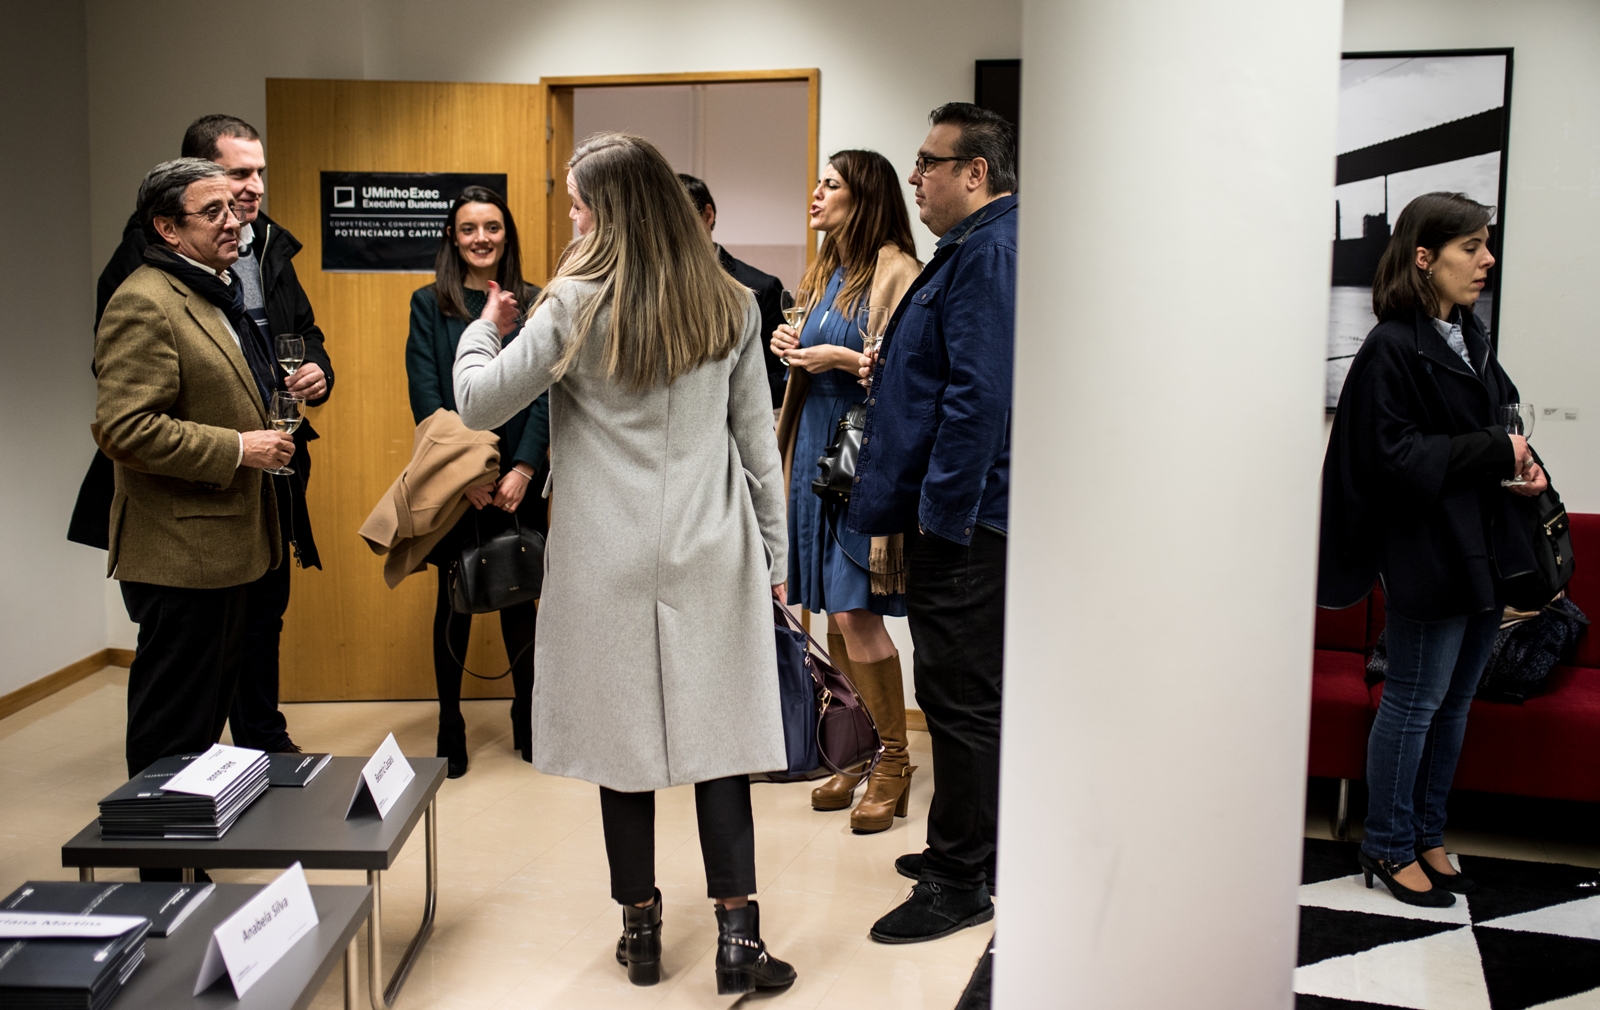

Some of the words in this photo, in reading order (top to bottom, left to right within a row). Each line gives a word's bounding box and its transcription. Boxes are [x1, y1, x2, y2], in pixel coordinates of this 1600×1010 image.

[362, 186, 440, 199] UMinhoExec
[362, 199, 406, 209] Executive
[407, 200, 448, 209] Business
[329, 219, 380, 228] COMPETÊNCIA
[334, 229, 405, 237] POTENCIAMOS
[408, 229, 443, 238] CAPITA
[0, 918, 37, 926] riana
[241, 910, 272, 943] Anabela
[271, 897, 289, 918] Silva
